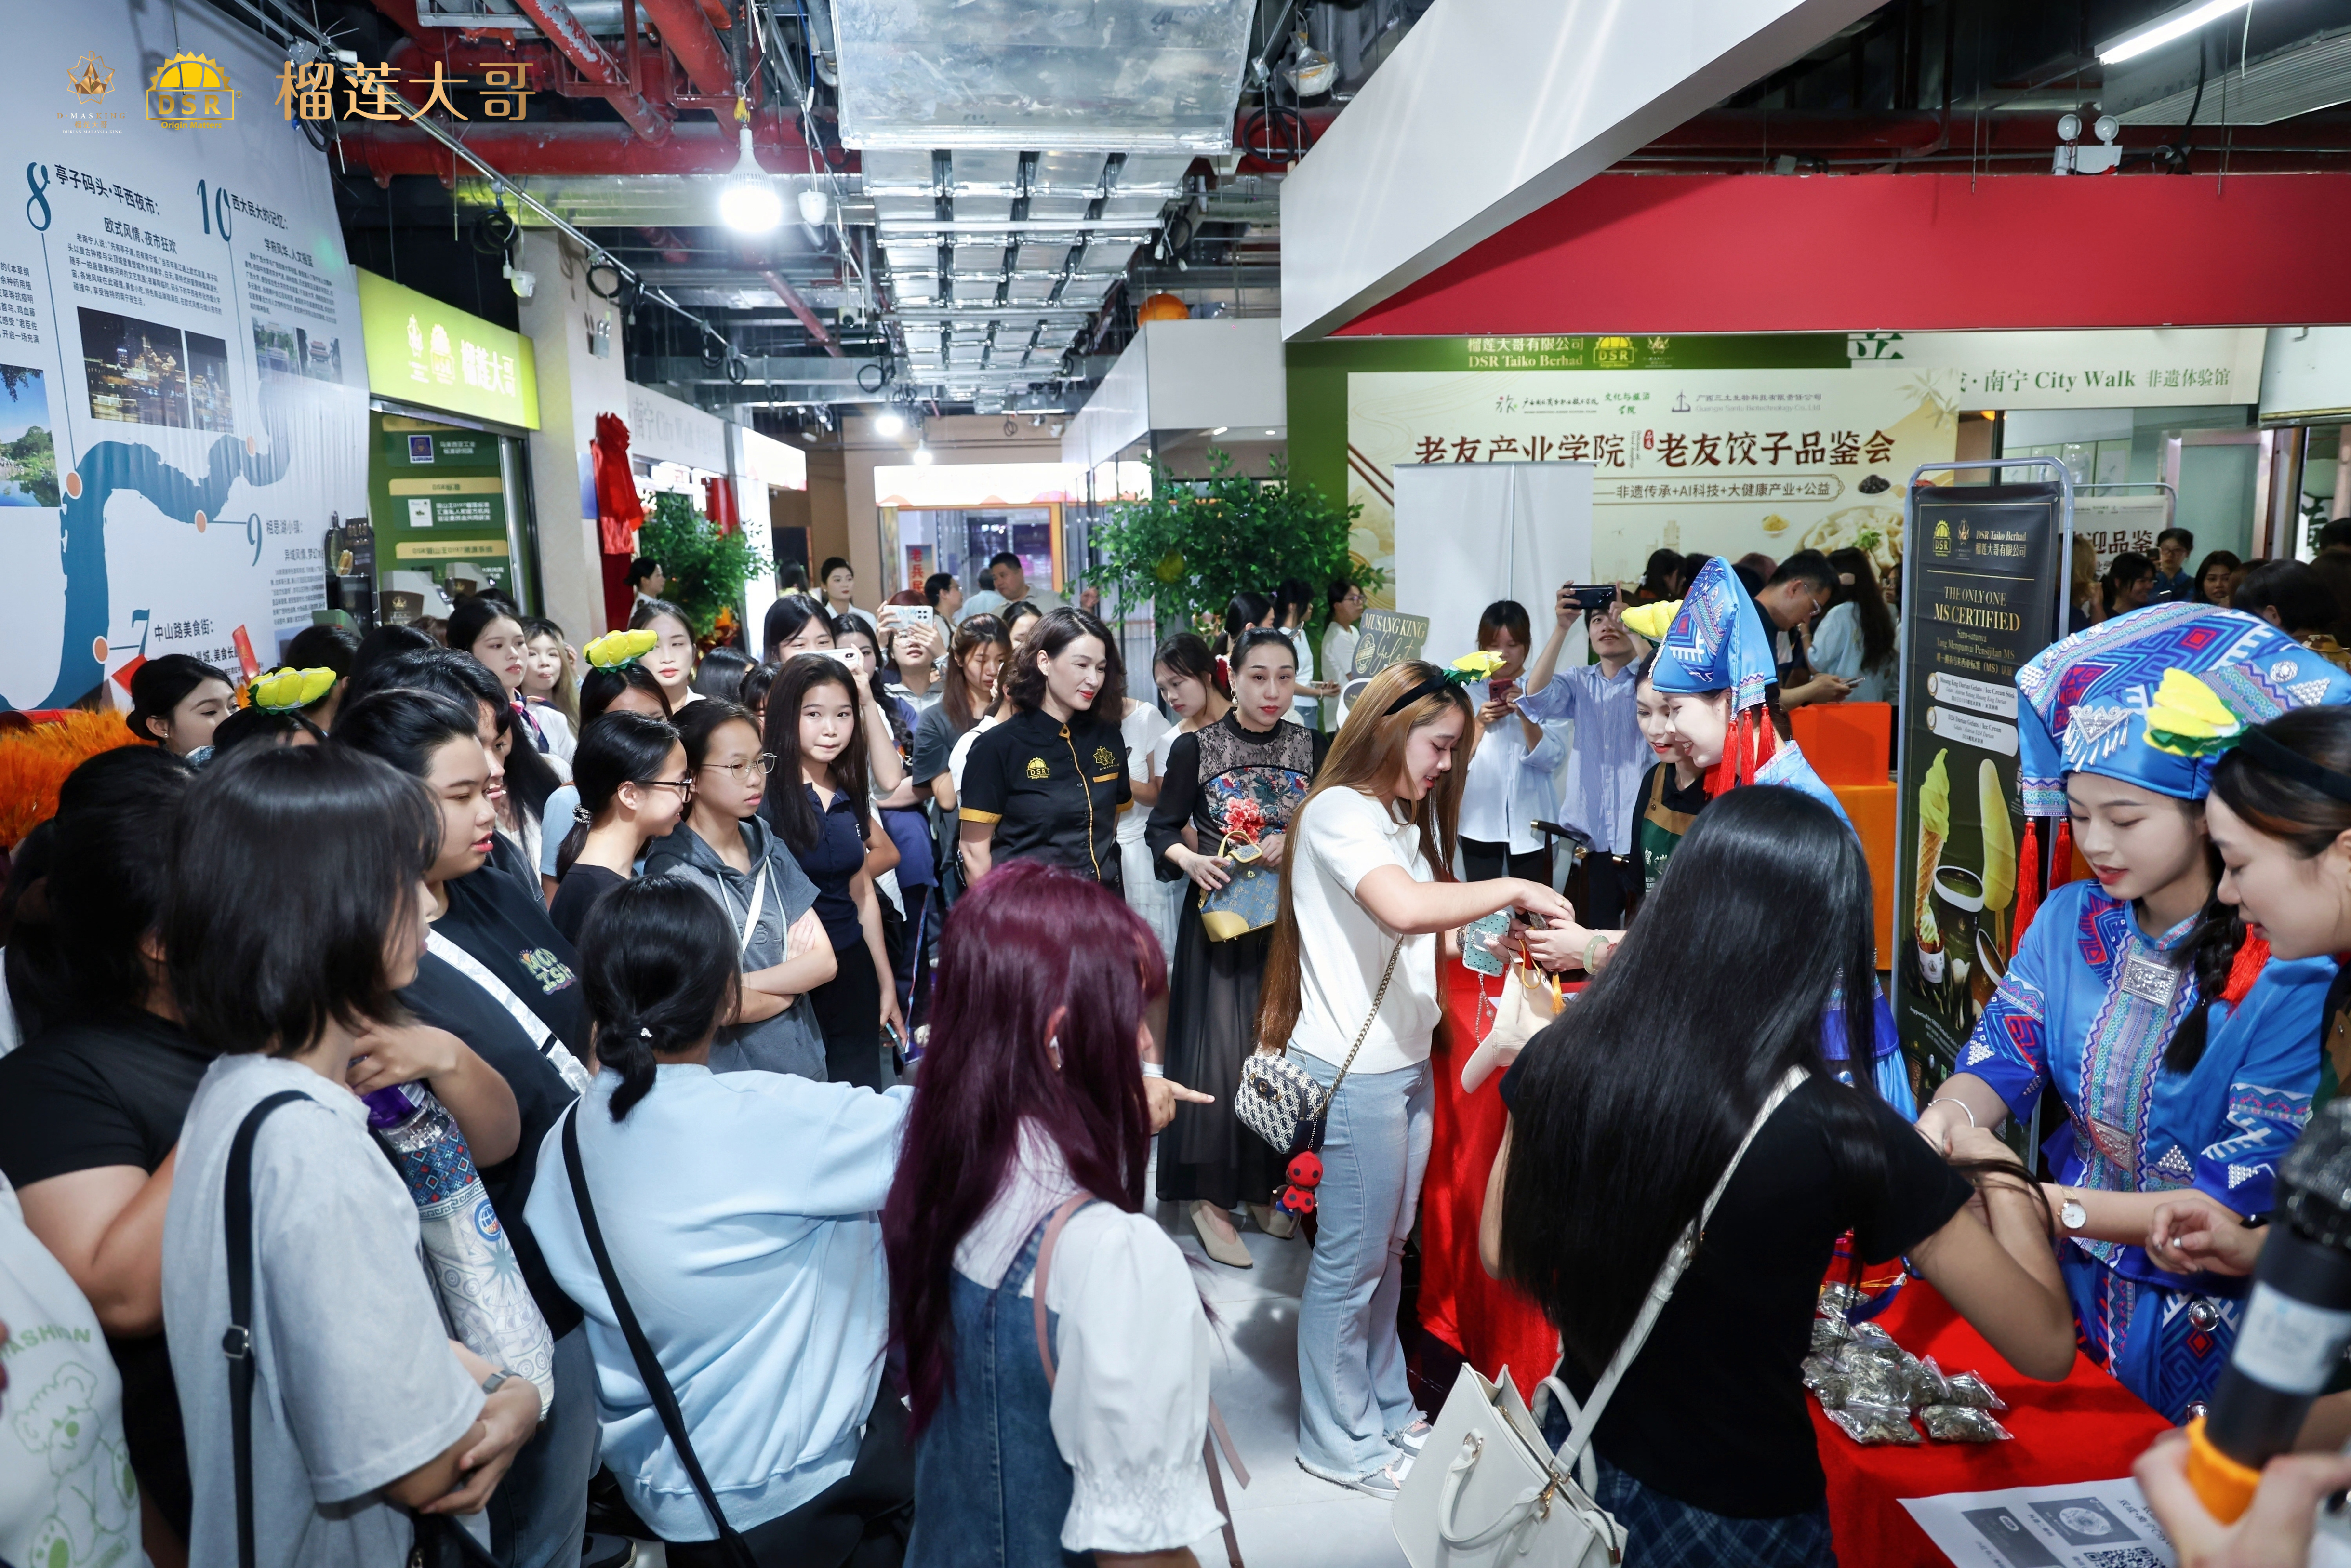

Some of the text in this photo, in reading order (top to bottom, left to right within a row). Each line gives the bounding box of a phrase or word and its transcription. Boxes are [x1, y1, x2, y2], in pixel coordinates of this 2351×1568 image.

[26, 162, 51, 231] 8
[197, 179, 232, 241] 10
[104, 217, 178, 254] 欧式风情、夜市狂欢
[0, 262, 30, 277] 的《本草纲
[0, 276, 32, 291] 余种药用植
[1467, 337, 1584, 353] 榴莲大哥有限公司
[1600, 350, 1628, 361] DSR
[1469, 355, 1583, 367] DSR Taiko Berhad
[2035, 371, 2077, 392] City
[2084, 370, 2137, 387] Walk
[2146, 368, 2231, 387] 非遗体验馆
[1604, 392, 1650, 401] 文化与旅游
[1618, 405, 1637, 414] 学院
[1415, 433, 1625, 468] 老友产业学院
[1656, 429, 1896, 467] 老友饺子品鉴会
[1616, 481, 1831, 499] 非遗传承+AI科技+大健康产业+公益
[247, 513, 262, 567] 9
[1935, 539, 1949, 550] DSR
[1976, 530, 2027, 542] DSR Taiko Berhad
[2073, 530, 2153, 555] 迎品鉴
[1944, 586, 2007, 607] THE ONLY ONE
[1362, 613, 1427, 639] MUSANG KING
[1933, 603, 2021, 632] MS CERTIFIED
[132, 608, 150, 655] 7
[183, 646, 239, 663] 邕城、美食长
[1369, 630, 1415, 675] Gelat
[2004, 649, 2015, 660] MS
